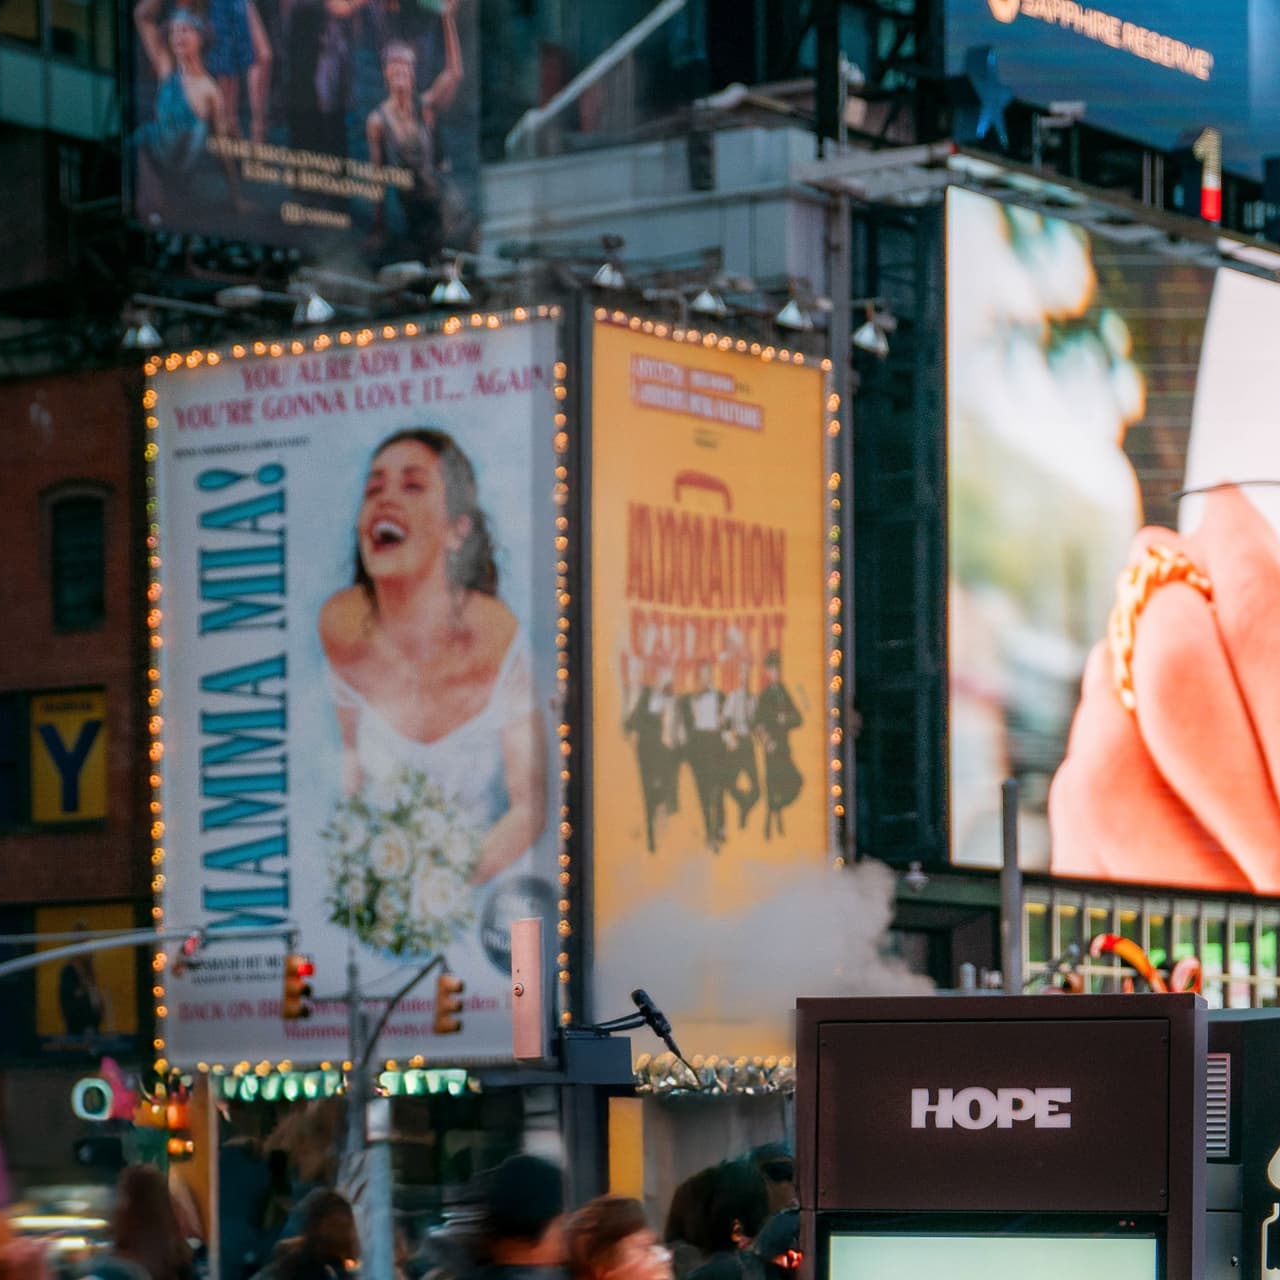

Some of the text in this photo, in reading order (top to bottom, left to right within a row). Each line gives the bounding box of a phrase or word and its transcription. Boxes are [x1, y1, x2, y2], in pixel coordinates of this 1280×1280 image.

[242, 340, 483, 393] YOU ALREADY KNOW
[173, 399, 253, 432] YOU'RE
[261, 391, 348, 422] GONNA
[354, 381, 413, 411] LOVE
[195, 462, 287, 637] MIA!
[200, 651, 291, 947] MAMMA
[911, 1087, 1072, 1130] HOPE
